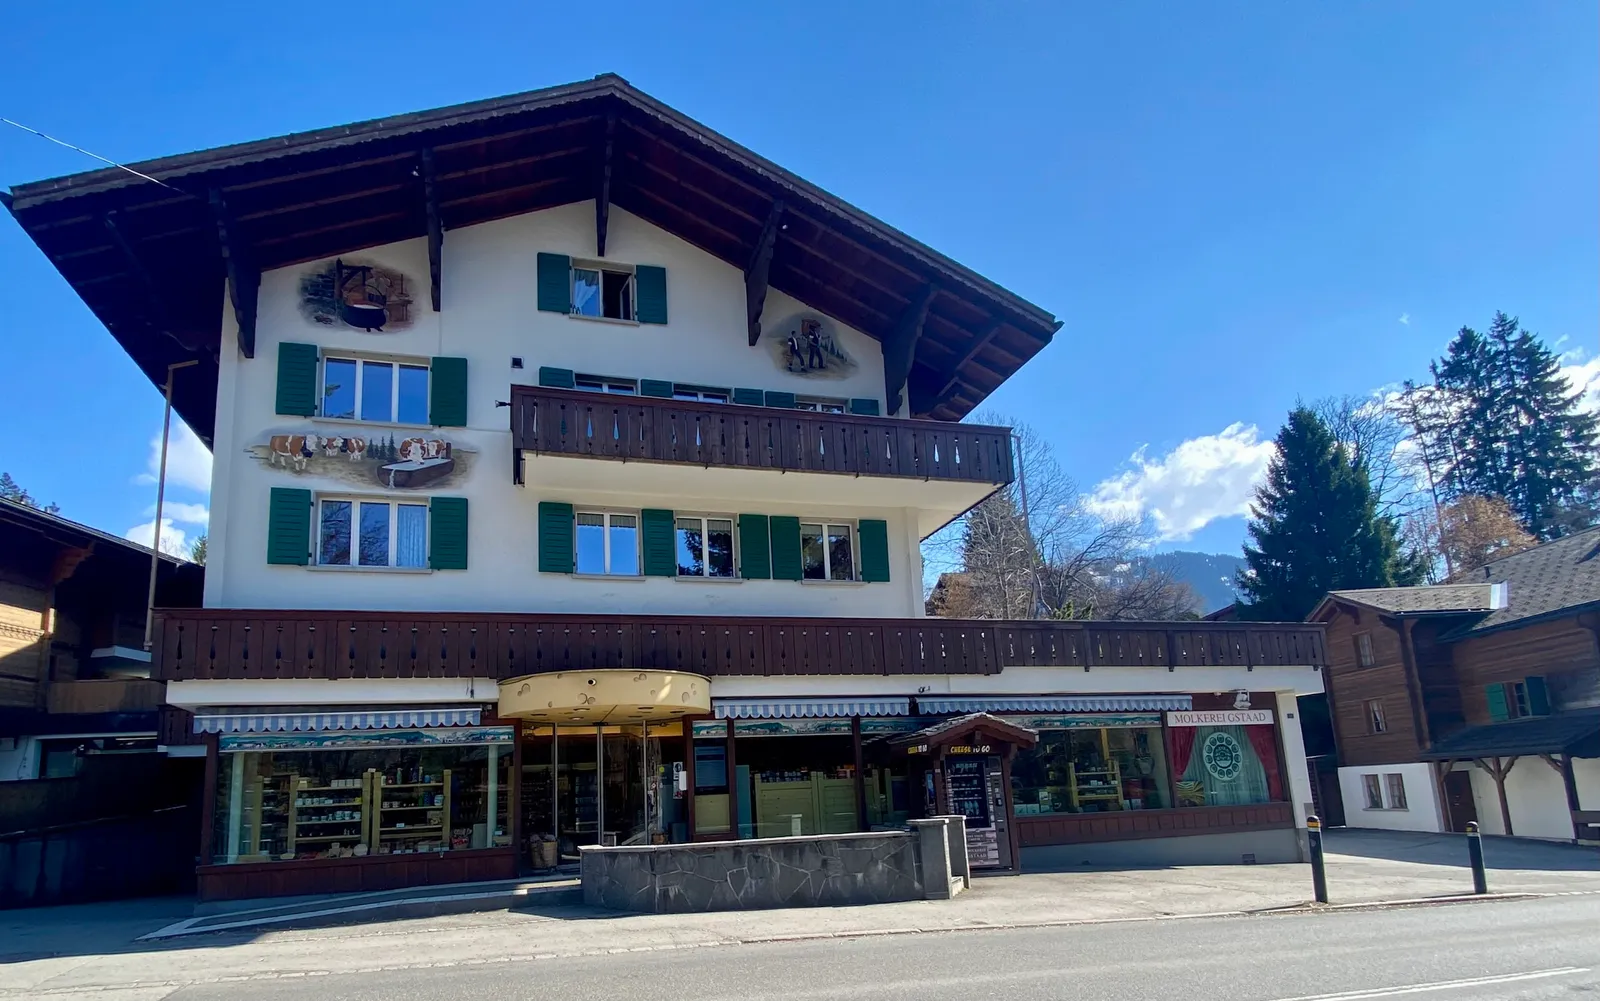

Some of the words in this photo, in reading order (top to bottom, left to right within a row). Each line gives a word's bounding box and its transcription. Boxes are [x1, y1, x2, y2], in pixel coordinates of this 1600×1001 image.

[1174, 713, 1225, 724] MOLKEREI
[1228, 712, 1266, 722] GSTAAD
[950, 745, 972, 754] CHEESE
[981, 745, 991, 753] GO
